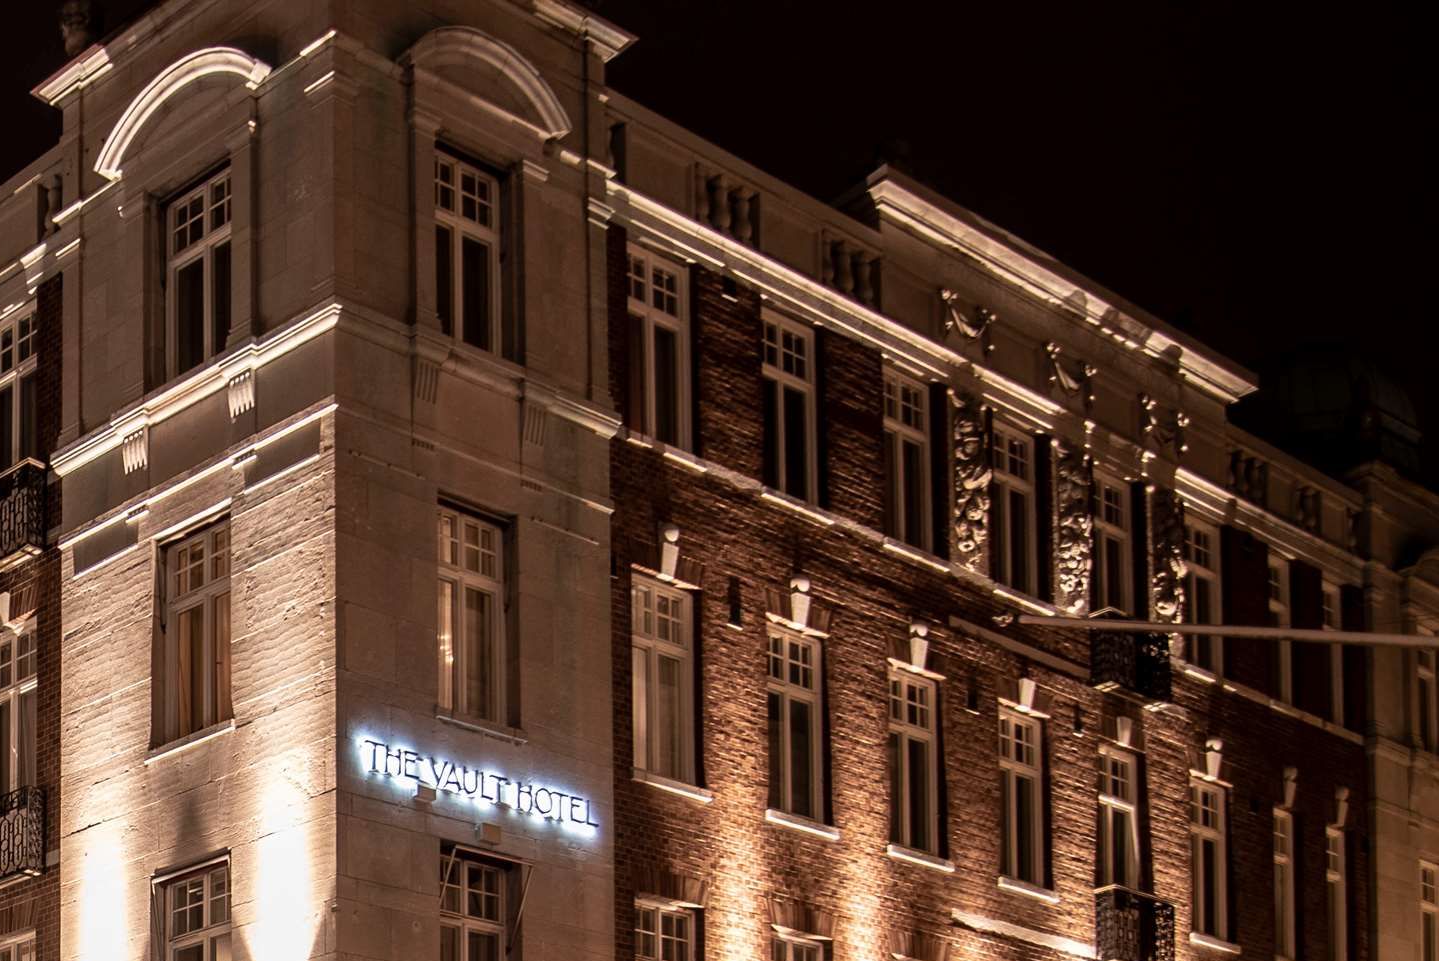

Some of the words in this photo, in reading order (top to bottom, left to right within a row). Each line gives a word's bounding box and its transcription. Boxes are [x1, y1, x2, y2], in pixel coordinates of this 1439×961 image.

[364, 739, 423, 780] THE
[427, 756, 511, 804] VAULT
[517, 781, 600, 828] HOTEL
